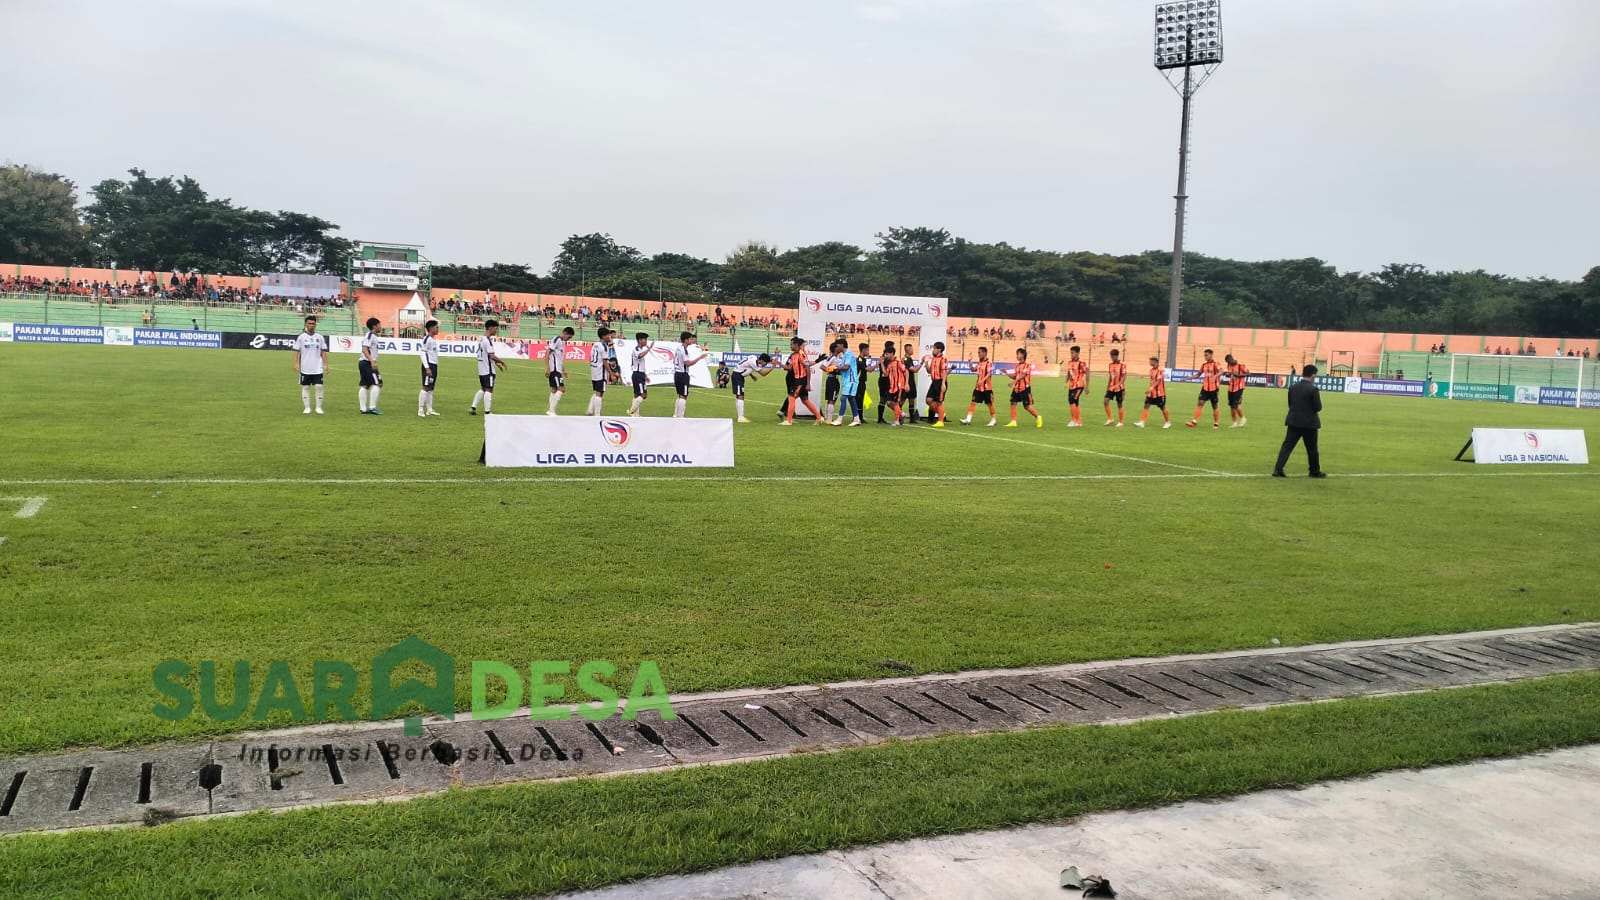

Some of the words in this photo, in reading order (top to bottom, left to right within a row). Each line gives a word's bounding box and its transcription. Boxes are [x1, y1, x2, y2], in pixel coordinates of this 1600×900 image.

[826, 303, 853, 312] LIGA
[855, 305, 864, 313] 3
[866, 305, 923, 315] NASIONAL
[15, 326, 42, 335] PAKAR
[62, 328, 103, 337] INDONESIA
[135, 330, 160, 339] PAKAR
[162, 331, 178, 340] IPAL
[180, 332, 220, 342] INDONESIA
[402, 342, 411, 351] 3
[1541, 389, 1563, 398] PAKAR
[536, 453, 578, 464] LIGA
[583, 453, 596, 464] 3
[601, 453, 693, 464] NASIONAL
[1499, 454, 1518, 462] LIGA
[1527, 454, 1569, 462] NASIONAL
